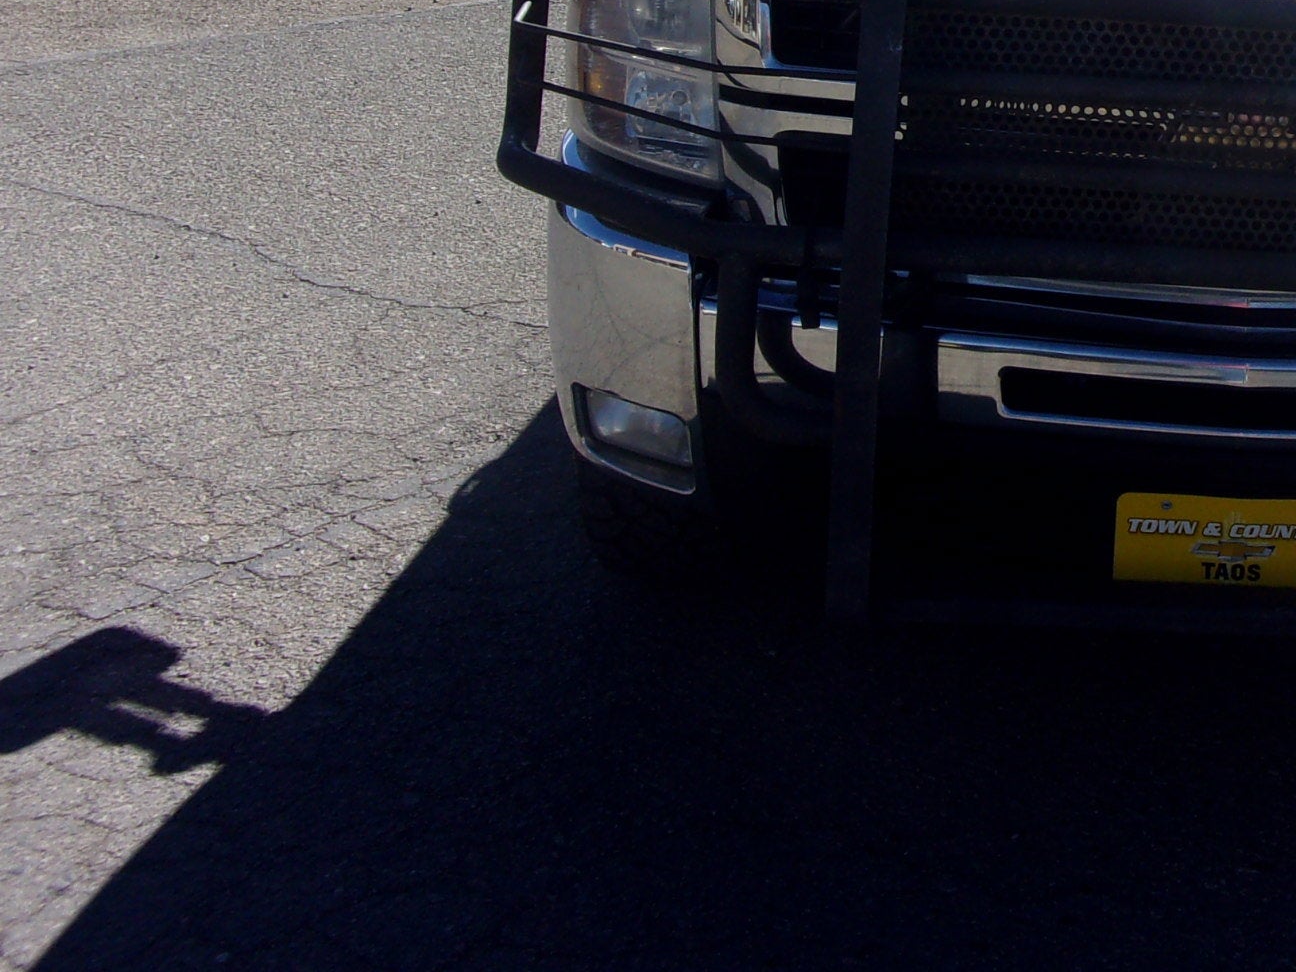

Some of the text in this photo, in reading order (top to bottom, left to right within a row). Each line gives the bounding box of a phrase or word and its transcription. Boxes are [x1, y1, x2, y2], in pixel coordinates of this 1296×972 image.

[1128, 517, 1198, 536] TOWN
[1202, 521, 1222, 538] &
[1201, 561, 1261, 582] TAOS
